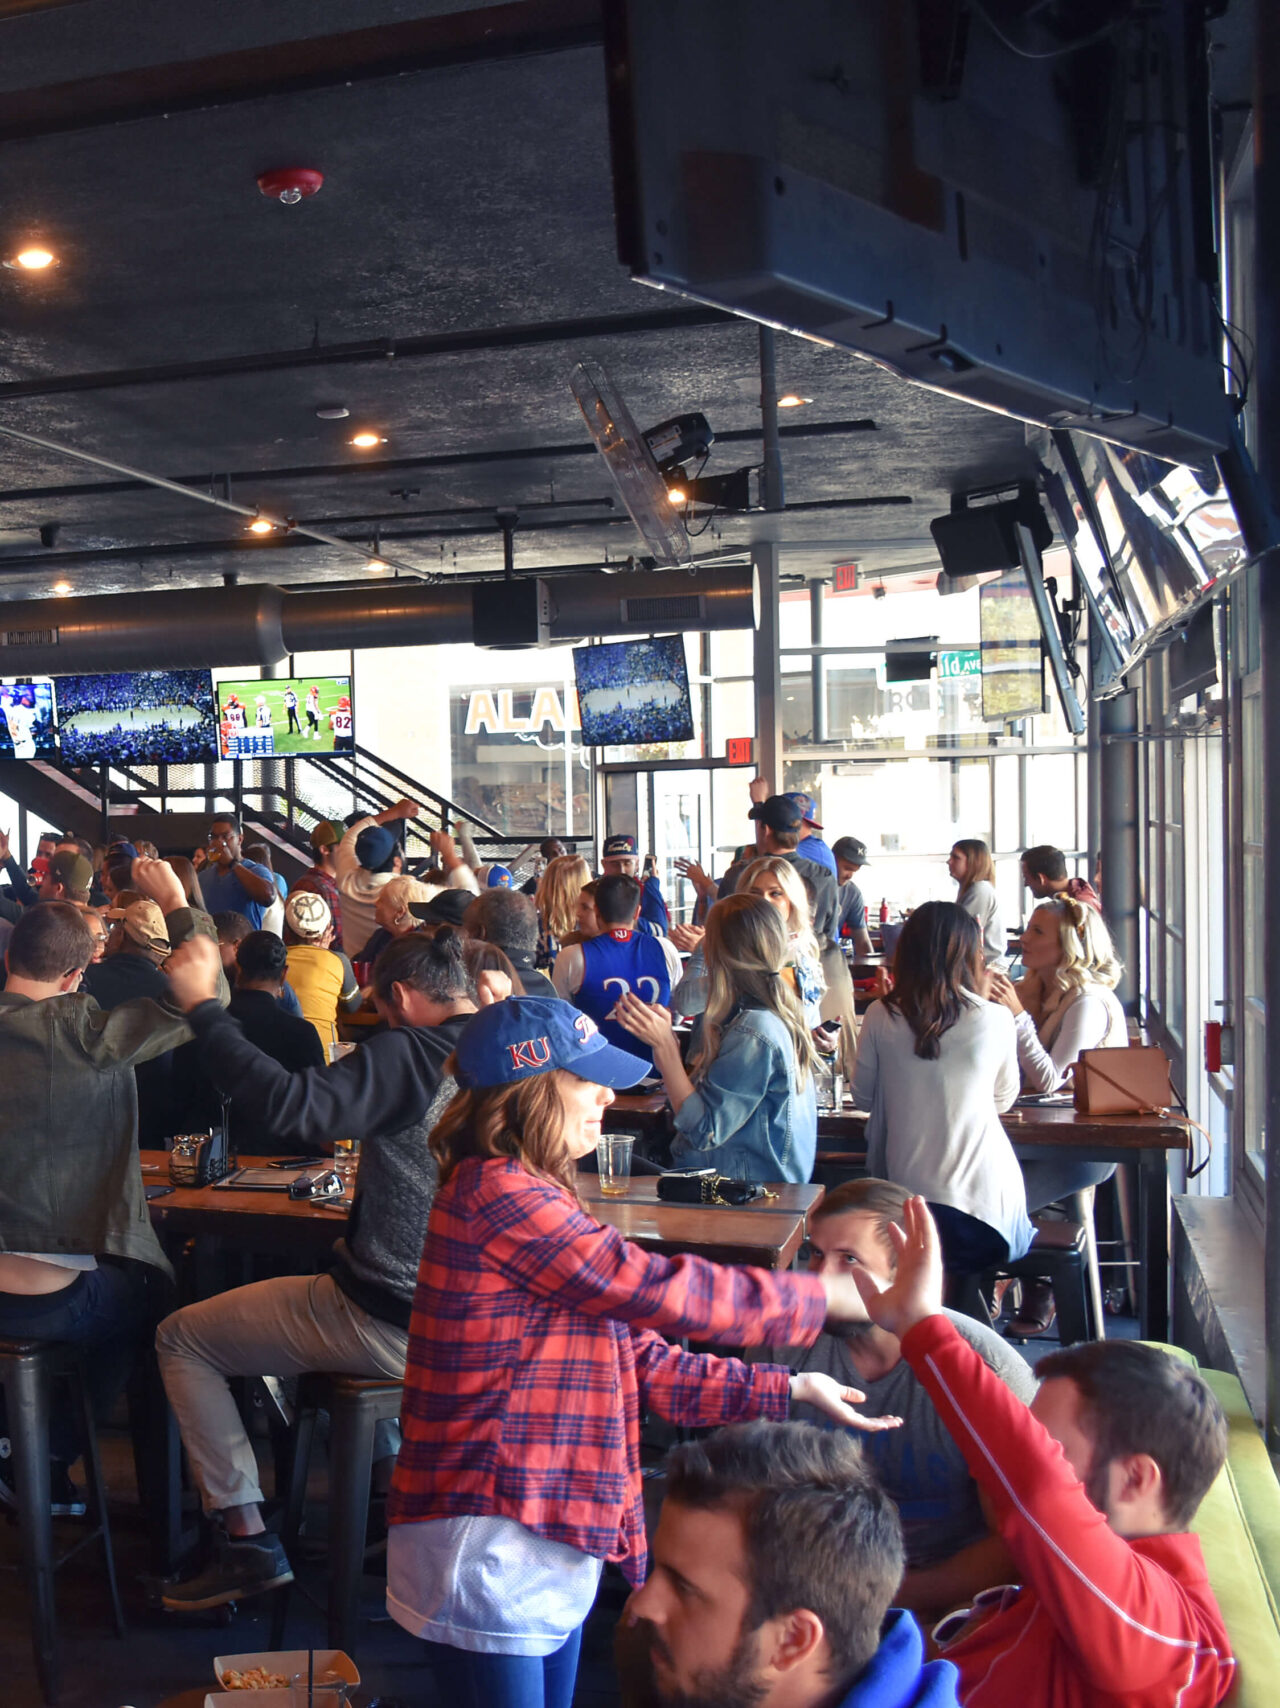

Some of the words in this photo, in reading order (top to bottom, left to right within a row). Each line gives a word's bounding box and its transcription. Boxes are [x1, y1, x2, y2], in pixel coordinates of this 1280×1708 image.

[335, 716, 351, 729] 82
[464, 687, 582, 735] ALA
[506, 1035, 552, 1070] KU
